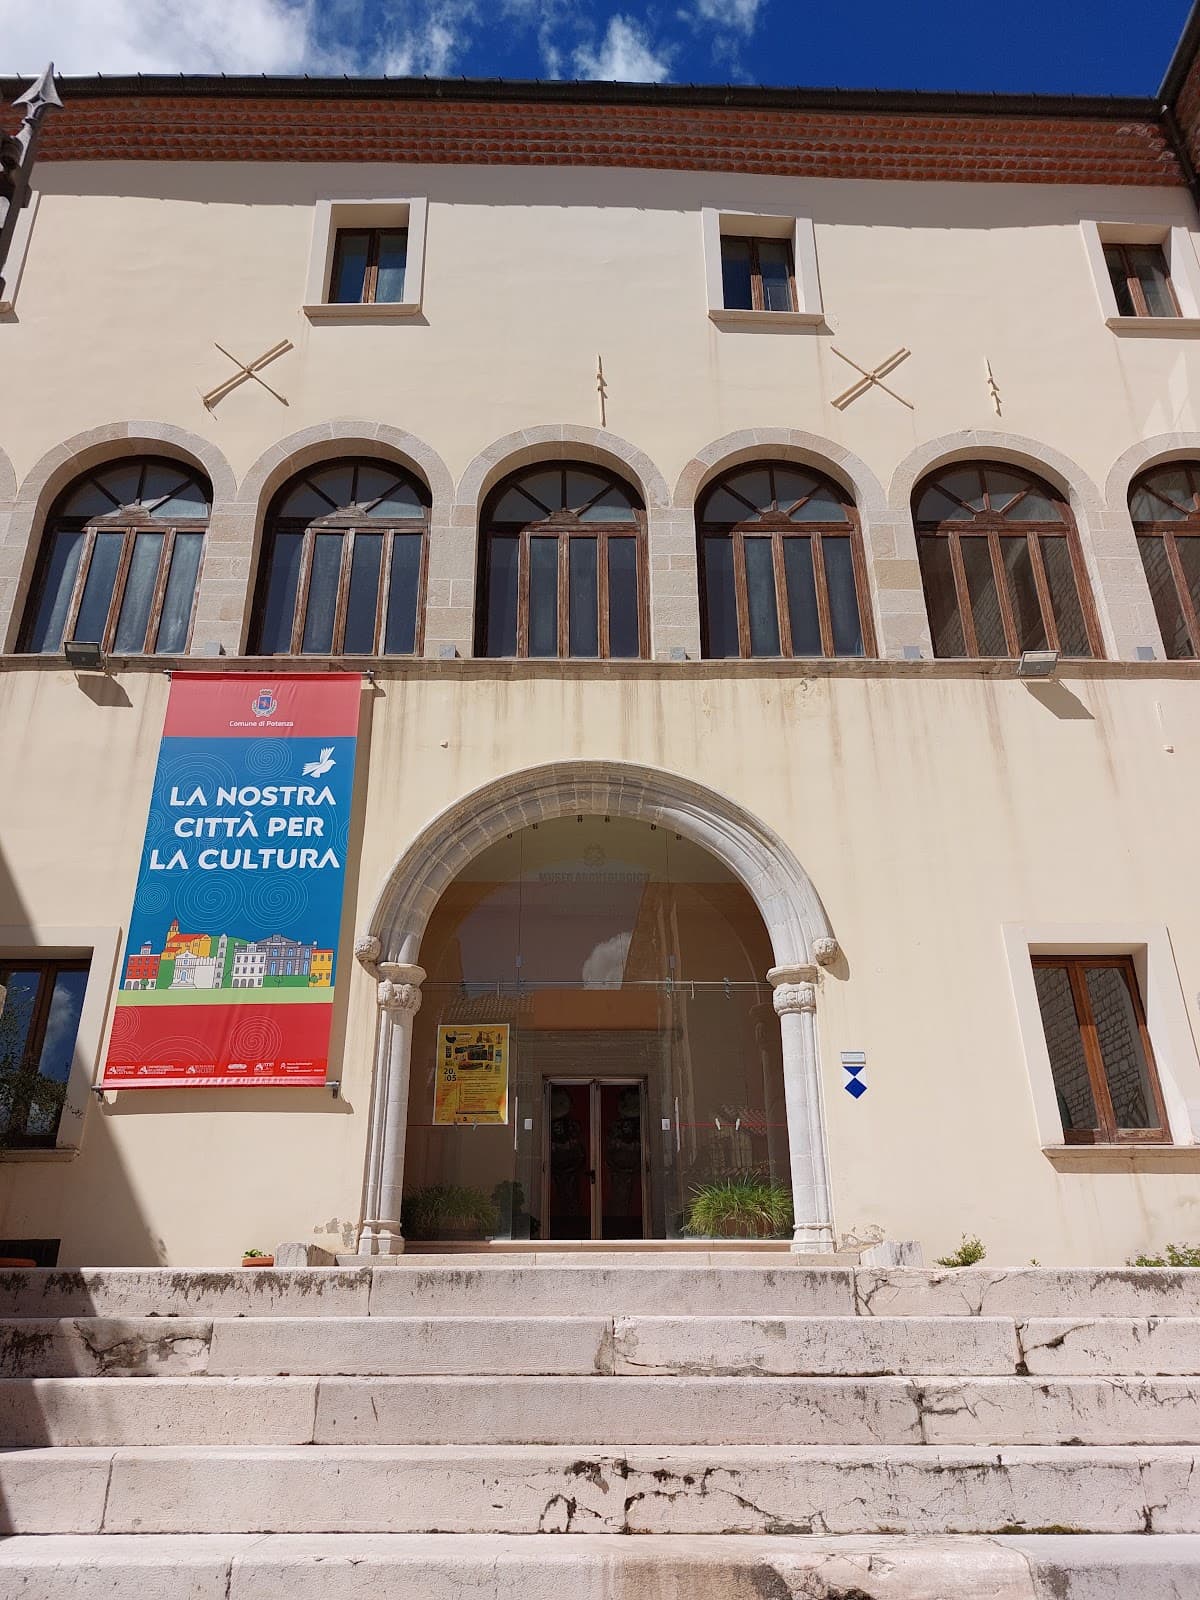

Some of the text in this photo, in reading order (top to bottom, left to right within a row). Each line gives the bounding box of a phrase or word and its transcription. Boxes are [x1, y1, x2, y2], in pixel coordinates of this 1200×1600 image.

[170, 786, 336, 806] LA NOSTRA
[175, 811, 324, 837] CITTÀ PER
[150, 848, 340, 870] LA CULTURA
